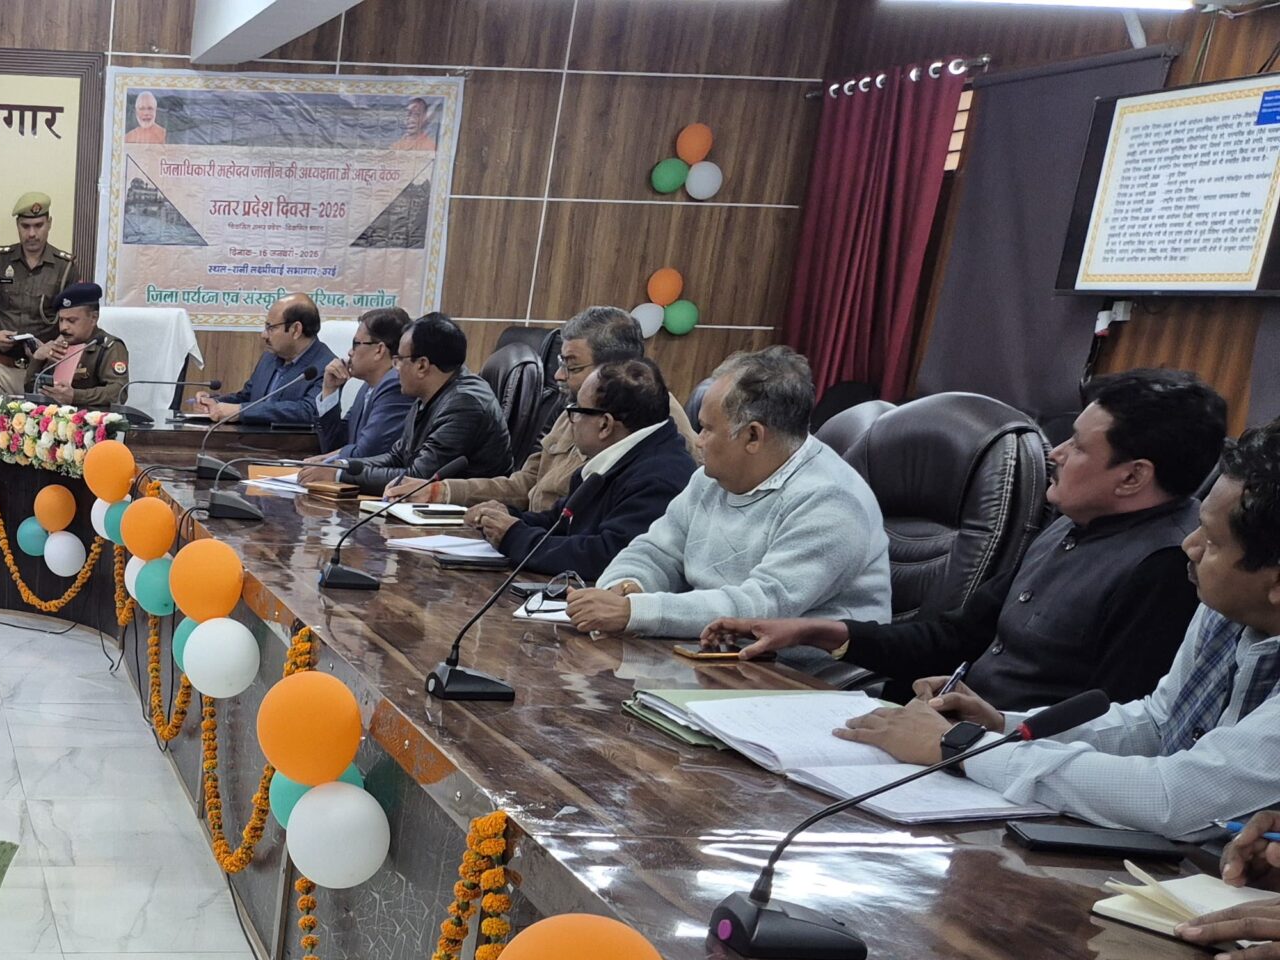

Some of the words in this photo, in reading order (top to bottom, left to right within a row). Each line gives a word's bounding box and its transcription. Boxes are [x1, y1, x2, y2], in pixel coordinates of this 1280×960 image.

[160, 158, 215, 176] जिलाधिकारी
[216, 160, 249, 178] महोदय
[250, 161, 282, 178] जालौन
[285, 161, 297, 179] की
[298, 166, 339, 181] अध्यक्षता
[340, 163, 352, 181] में
[209, 199, 240, 216] उत्तर
[242, 195, 273, 217] प्रदेश
[146, 284, 178, 303] जिला
[181, 285, 219, 304] पर्यटन
[222, 288, 240, 305] एवं
[352, 291, 396, 307] जालौन
